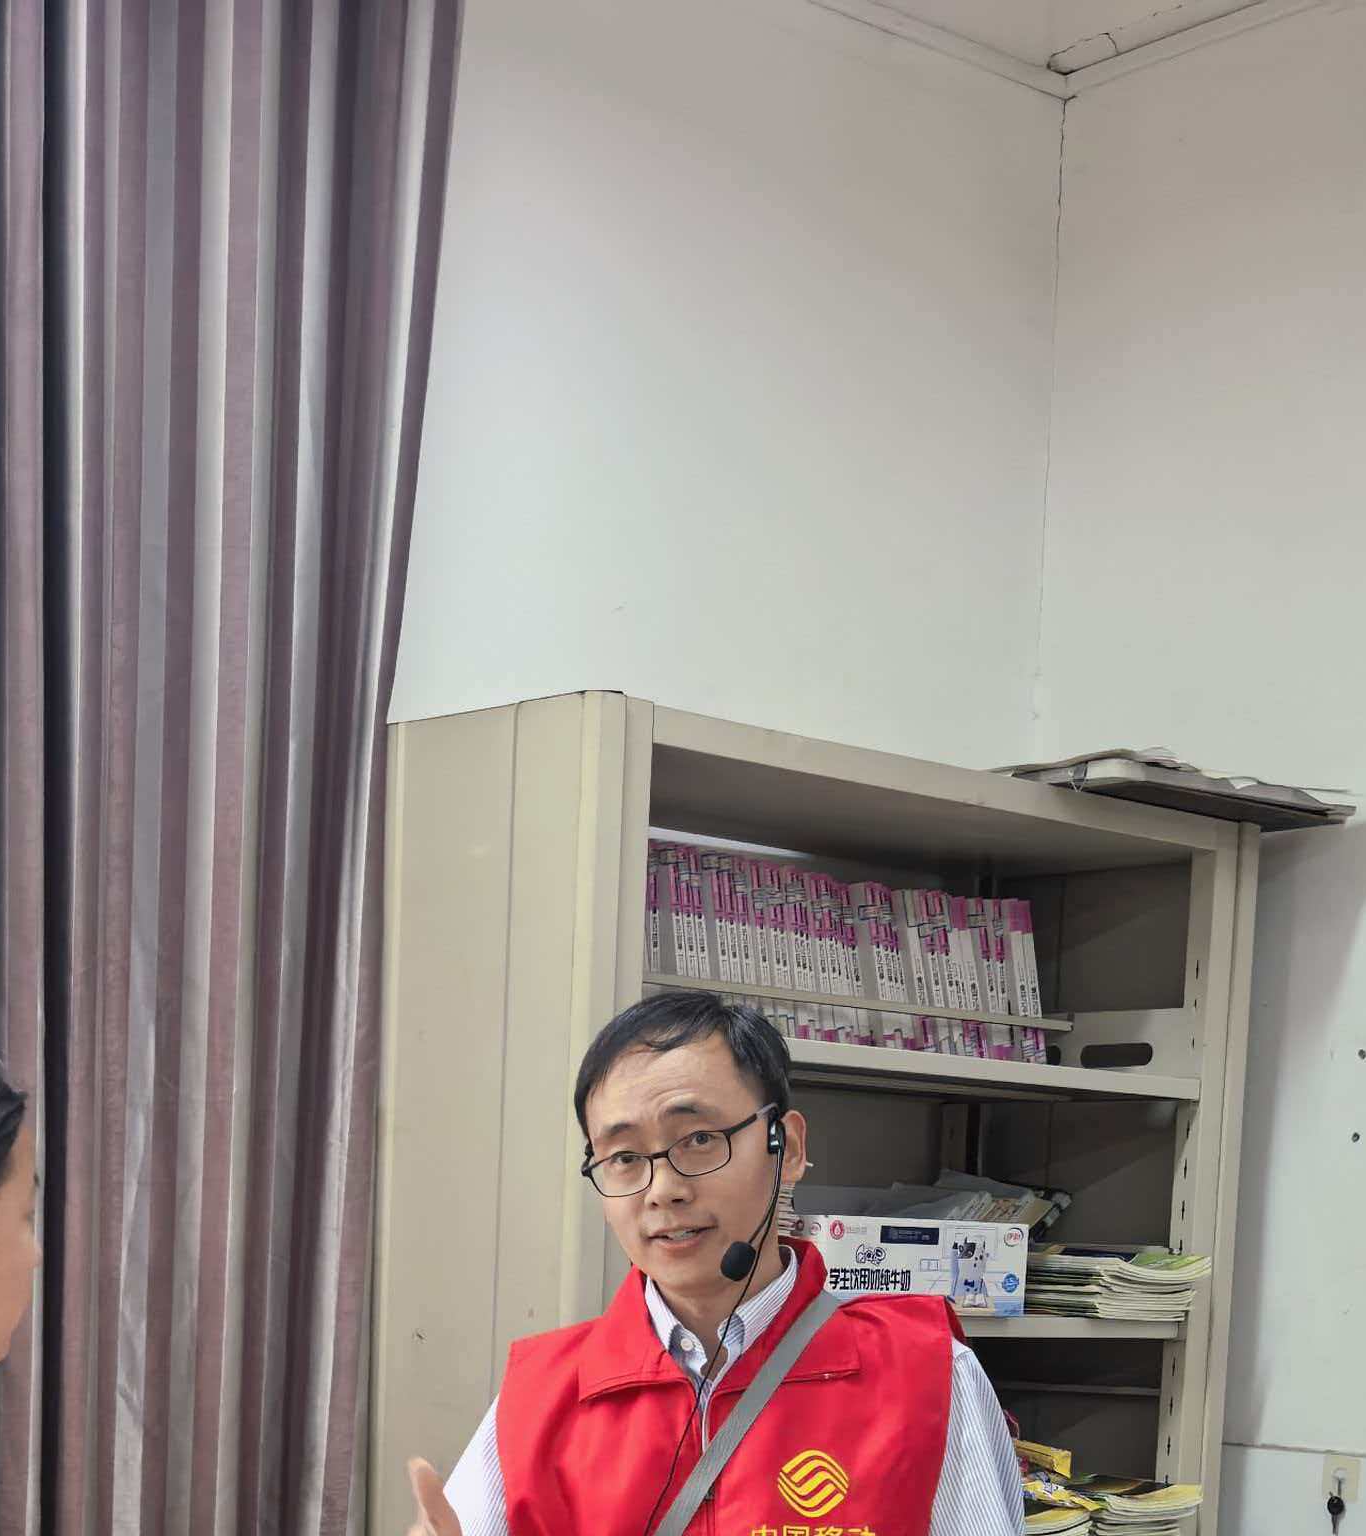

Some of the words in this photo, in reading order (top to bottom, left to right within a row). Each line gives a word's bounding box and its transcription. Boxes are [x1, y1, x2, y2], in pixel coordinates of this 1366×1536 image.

[829, 1267, 911, 1291] 学生饮用奶纯牛奶
